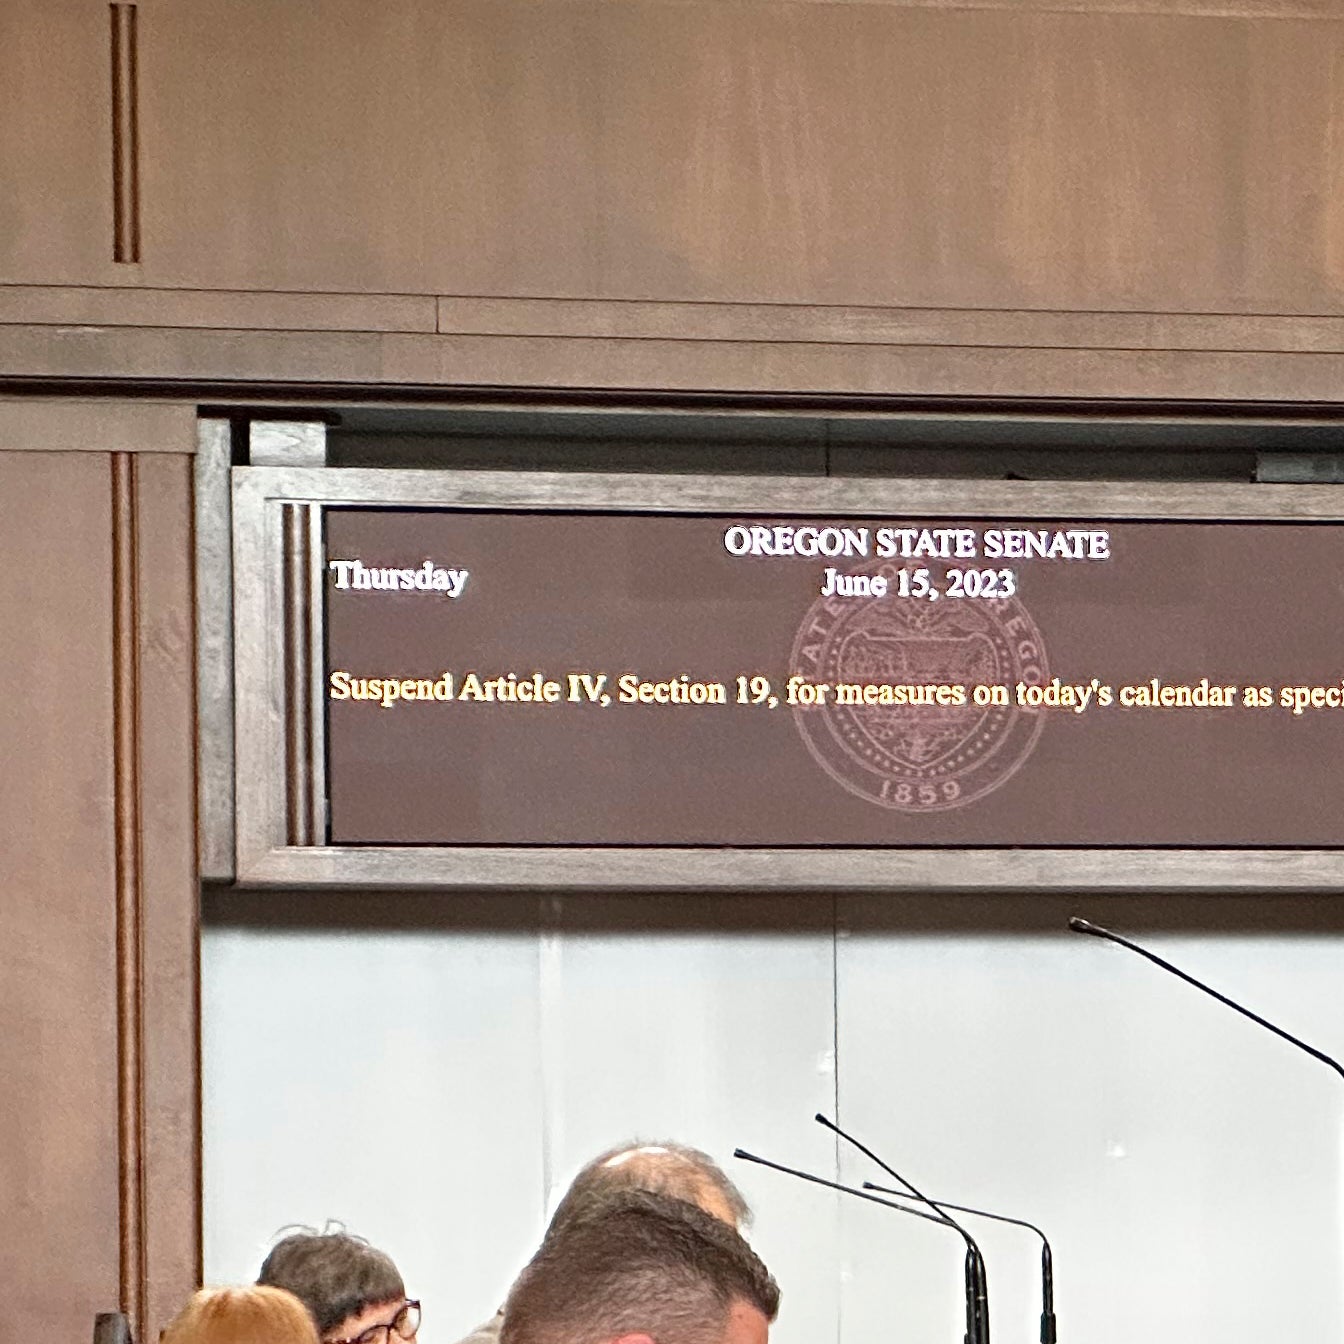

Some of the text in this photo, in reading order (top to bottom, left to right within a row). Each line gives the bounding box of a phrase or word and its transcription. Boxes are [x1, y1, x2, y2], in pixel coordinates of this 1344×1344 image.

[724, 525, 1111, 559] OREGON STATE SENATE
[331, 559, 469, 598] Thursday
[821, 567, 888, 597] June
[897, 569, 939, 601] 15,
[946, 569, 1016, 599] 2023
[330, 671, 454, 708] Suspend
[458, 672, 561, 703] Article
[567, 674, 611, 708] IV,
[618, 674, 727, 704] Section
[736, 675, 778, 710] 19,
[786, 675, 829, 705] for
[835, 682, 967, 706] measures
[973, 683, 1010, 706] on
[1015, 677, 1113, 714] today's
[1119, 678, 1236, 707] calendar
[1243, 685, 1273, 708] as
[879, 778, 961, 806] 1859
